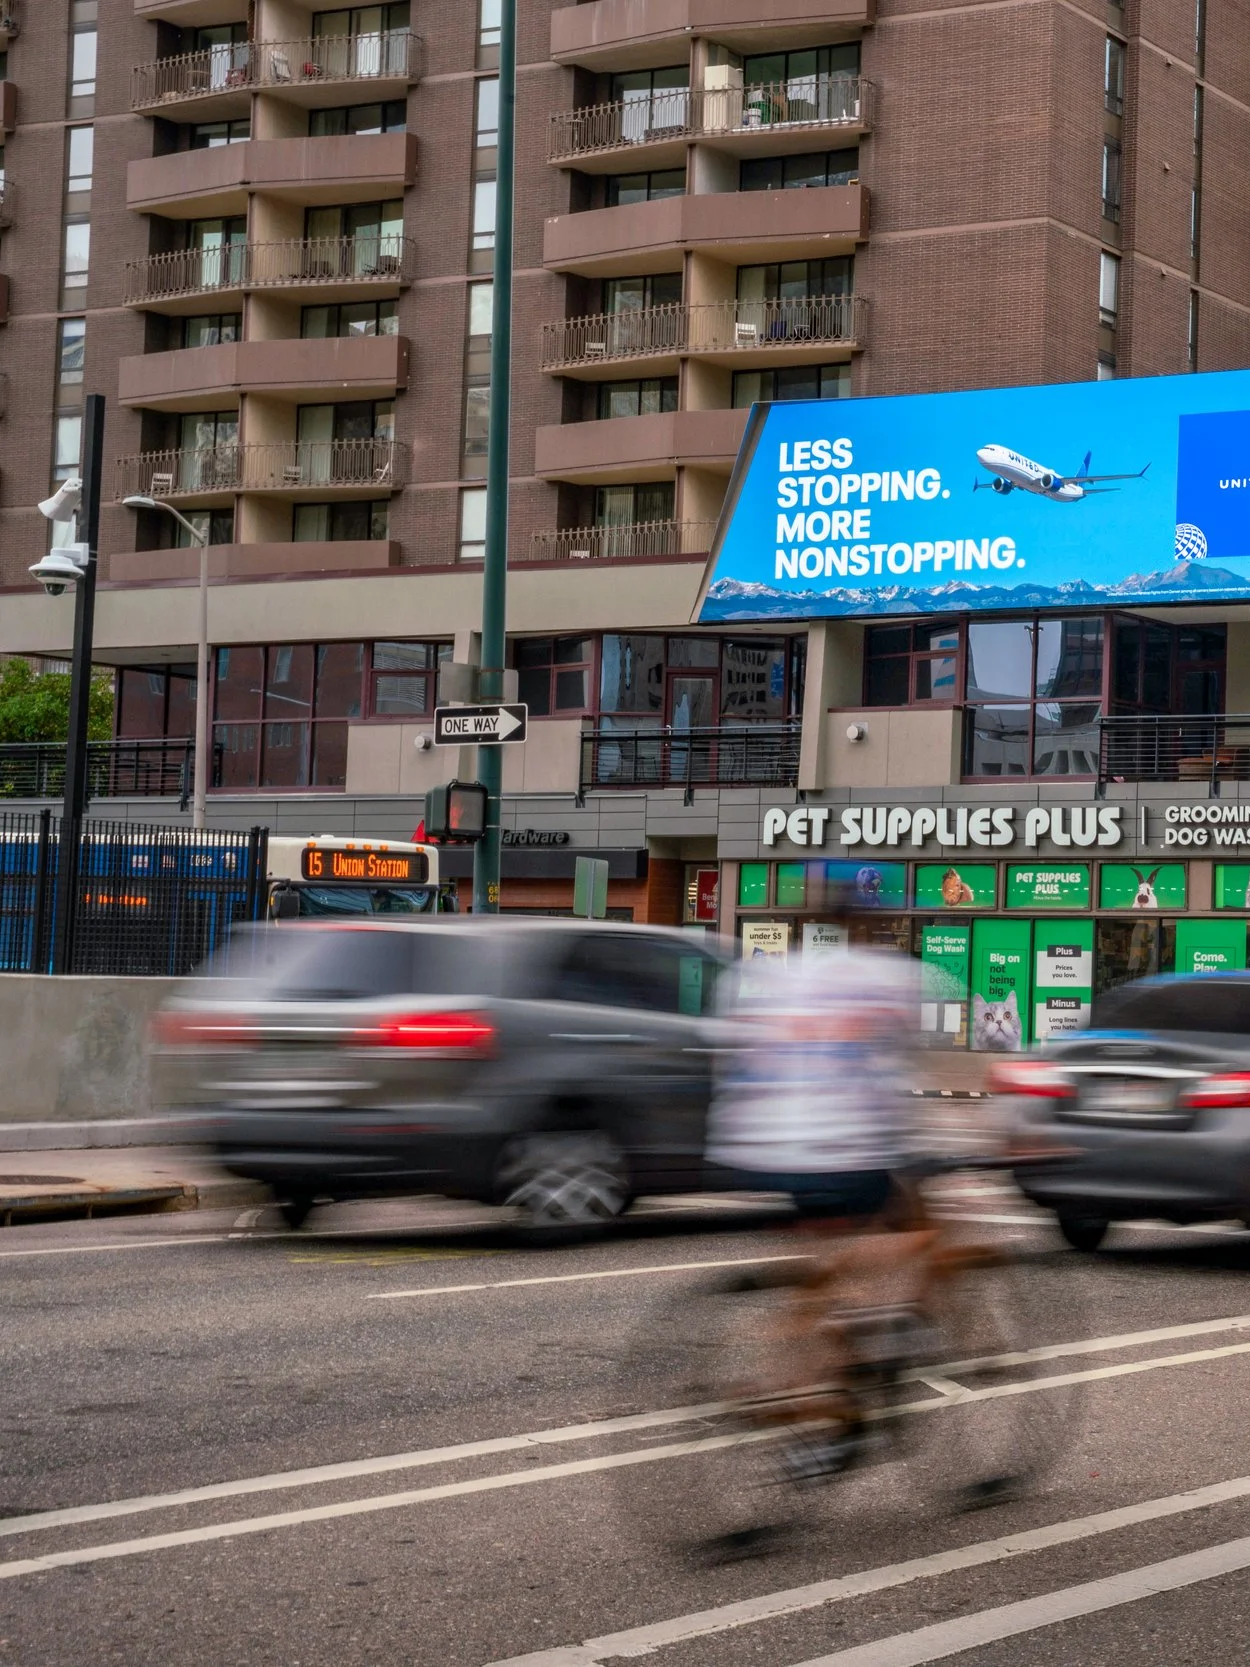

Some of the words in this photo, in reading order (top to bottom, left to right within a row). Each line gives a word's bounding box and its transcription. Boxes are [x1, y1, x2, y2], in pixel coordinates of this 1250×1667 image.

[779, 438, 853, 472] LESS
[777, 468, 950, 508] STOPPING.
[776, 509, 871, 543] MORE
[775, 536, 1026, 579] NONSTOPPING.
[444, 719, 469, 733] ONE
[473, 717, 499, 732] WAY
[763, 807, 830, 846] PET
[840, 806, 1014, 847] SUPPLIES
[1025, 806, 1124, 848] PLUS
[500, 829, 567, 845] ardware
[1165, 828, 1209, 845] DOG
[309, 852, 322, 876] 15
[1015, 872, 1034, 883] PET
[1036, 872, 1081, 883] SUPPLIES
[1035, 884, 1060, 894] PLUS
[772, 932, 782, 941] $5
[812, 935, 818, 943] 6
[820, 935, 840, 943] FREE
[926, 936, 966, 944] Self-Serve
[926, 945, 943, 954] Dog
[944, 945, 965, 953] Wash
[1055, 947, 1073, 956] Plus
[989, 953, 1006, 964] Big
[1193, 952, 1227, 962] Come.
[989, 965, 1006, 974] not
[989, 975, 1015, 987] being
[989, 986, 1006, 997] big.
[1051, 999, 1076, 1008] Minus
